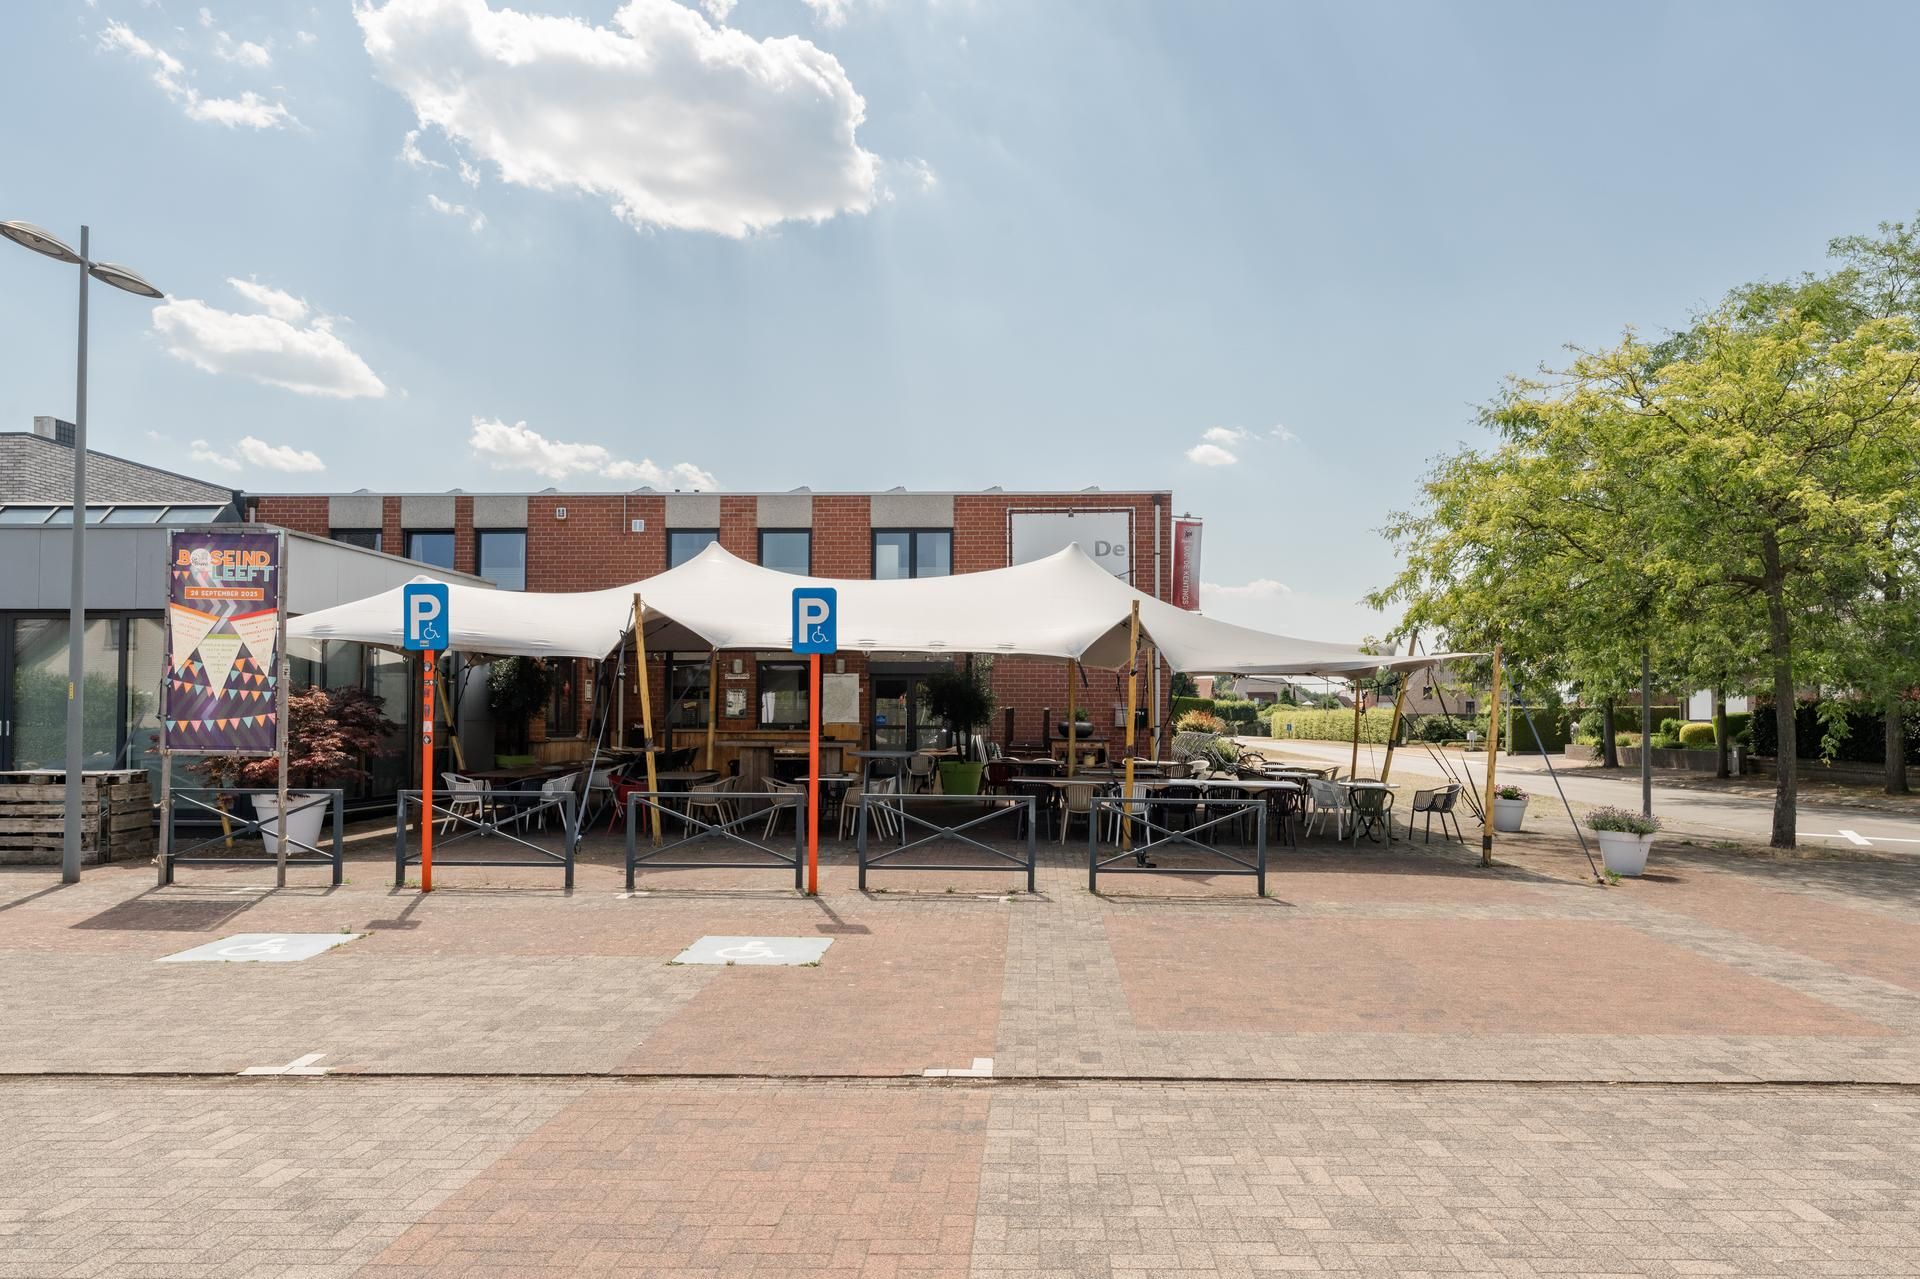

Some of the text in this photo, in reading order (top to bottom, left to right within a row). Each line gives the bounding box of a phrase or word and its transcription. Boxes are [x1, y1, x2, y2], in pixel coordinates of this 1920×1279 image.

[1095, 541, 1126, 557] De
[212, 566, 275, 582] LEEFT
[410, 594, 441, 640] P
[799, 598, 830, 643] P
